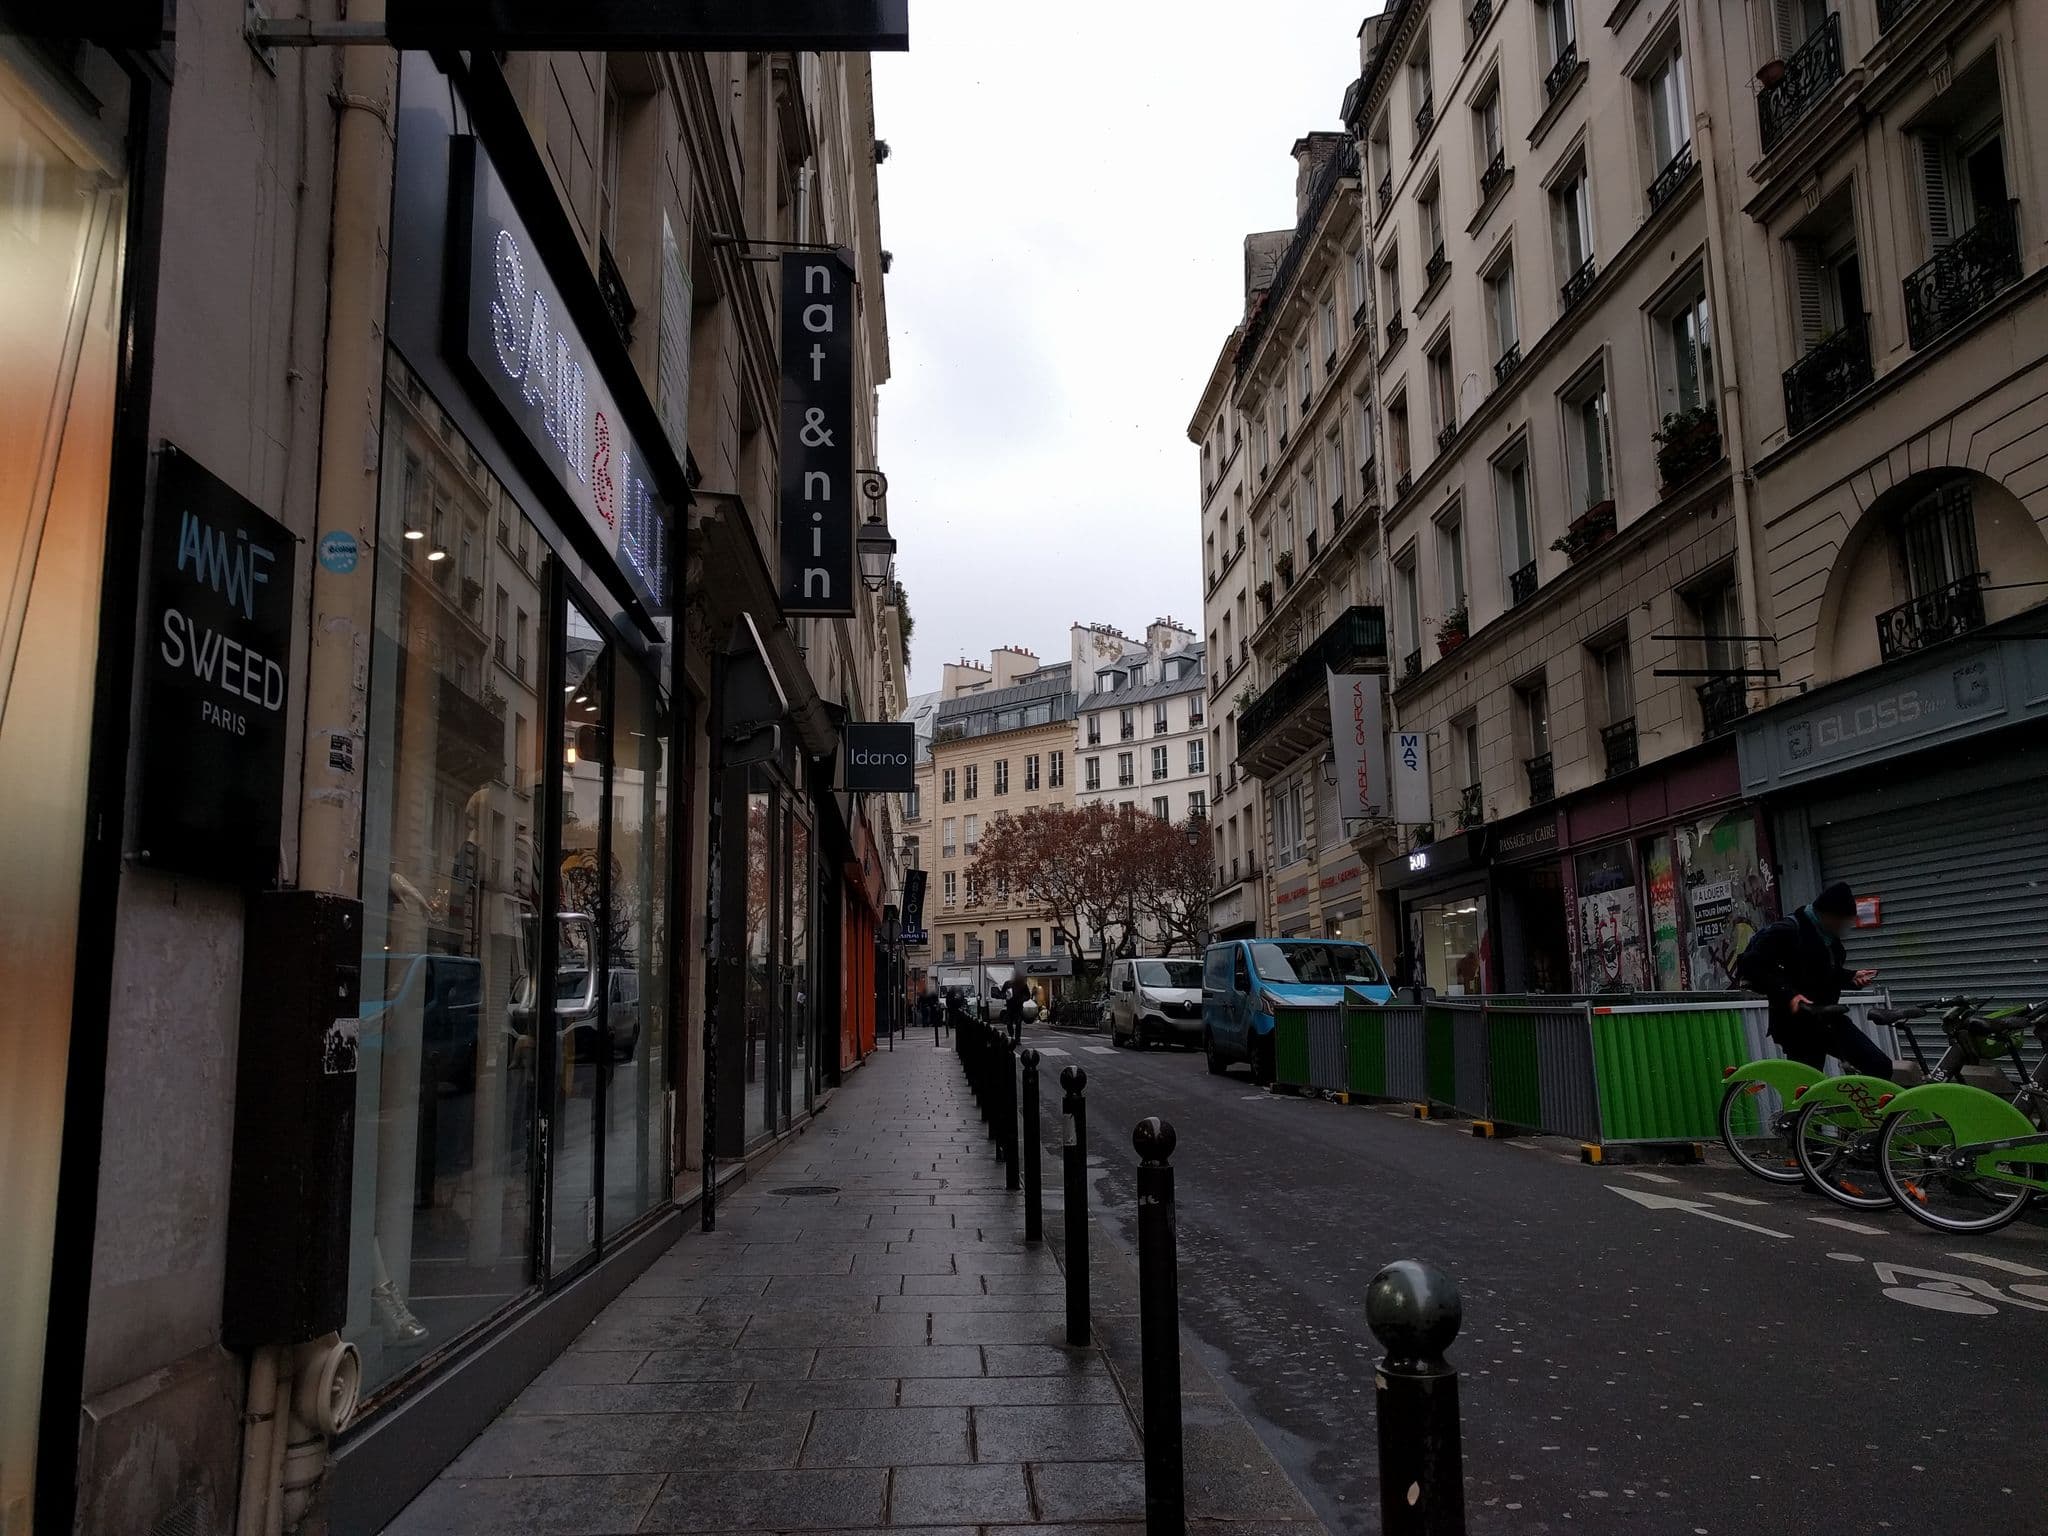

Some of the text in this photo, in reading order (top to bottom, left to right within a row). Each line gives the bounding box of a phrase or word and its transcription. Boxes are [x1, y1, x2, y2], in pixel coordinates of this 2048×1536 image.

[799, 265, 835, 598] nat & nin
[160, 608, 284, 711] SWEED
[202, 700, 247, 736] PARIS
[1353, 681, 1365, 746] GARCIA
[1816, 690, 1922, 746] GLOSS
[850, 748, 908, 766] Idano
[1499, 833, 1526, 853] PASSAGE
[1535, 824, 1557, 841] CAIRE
[1704, 886, 1725, 900] LOUER
[1695, 911, 1702, 920] LA
[1702, 907, 1716, 917] TOUR
